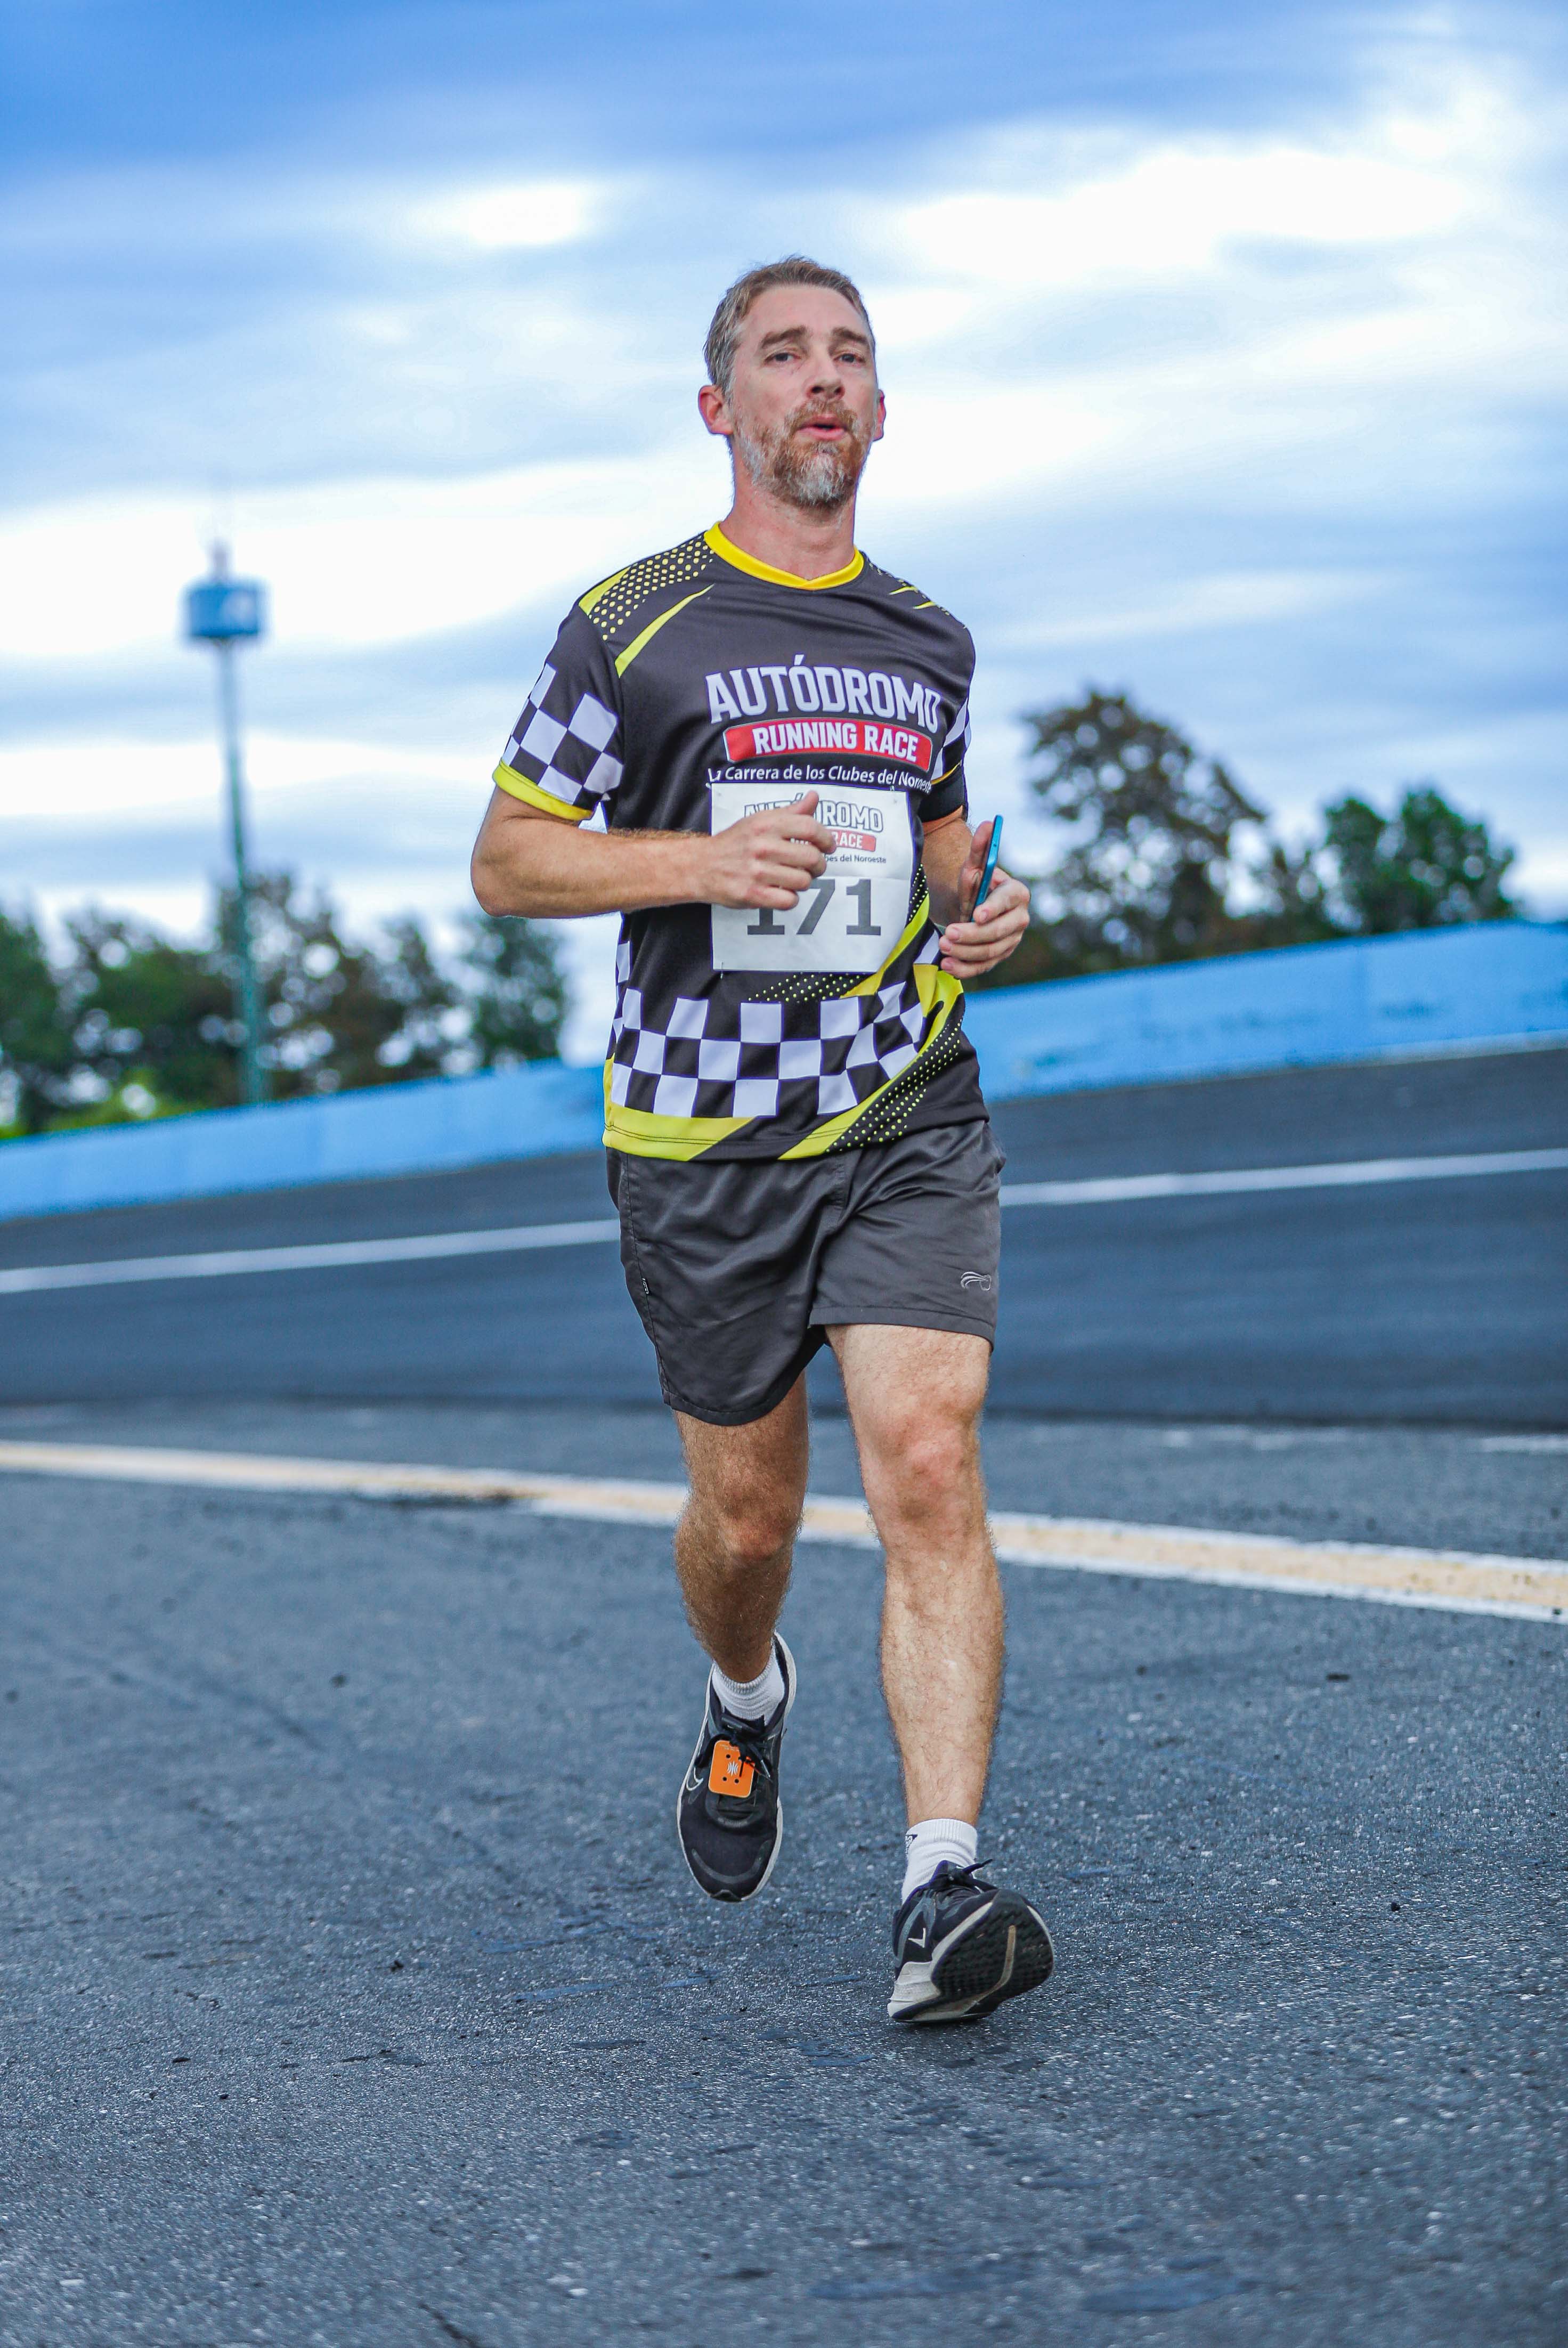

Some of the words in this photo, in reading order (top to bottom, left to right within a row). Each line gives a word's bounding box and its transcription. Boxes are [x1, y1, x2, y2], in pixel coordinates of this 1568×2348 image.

[705, 654, 942, 733] AUTÓDROMO
[751, 721, 857, 755] RUNNING
[863, 726, 919, 762] RACE
[725, 766, 779, 780] Carrera
[783, 764, 803, 780] de
[806, 764, 825, 781] los
[827, 765, 875, 784] Clubes
[877, 769, 898, 785] del
